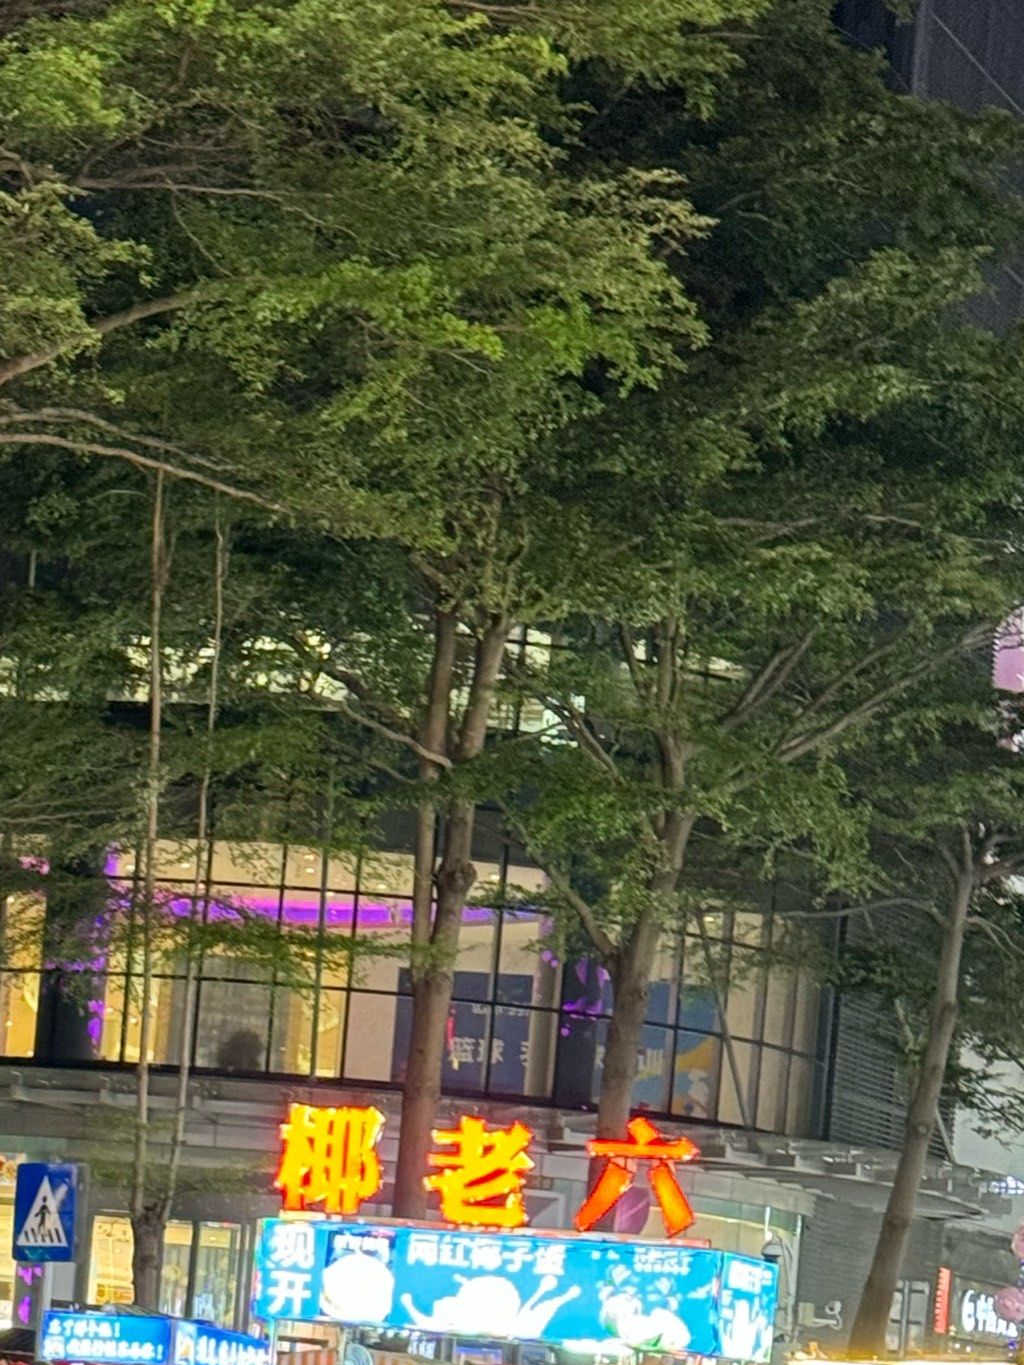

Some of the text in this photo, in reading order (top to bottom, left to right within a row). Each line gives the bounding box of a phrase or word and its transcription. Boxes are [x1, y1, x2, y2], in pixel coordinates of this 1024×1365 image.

[275, 1092, 698, 1238] 椰老六
[265, 1222, 315, 1316] 现开
